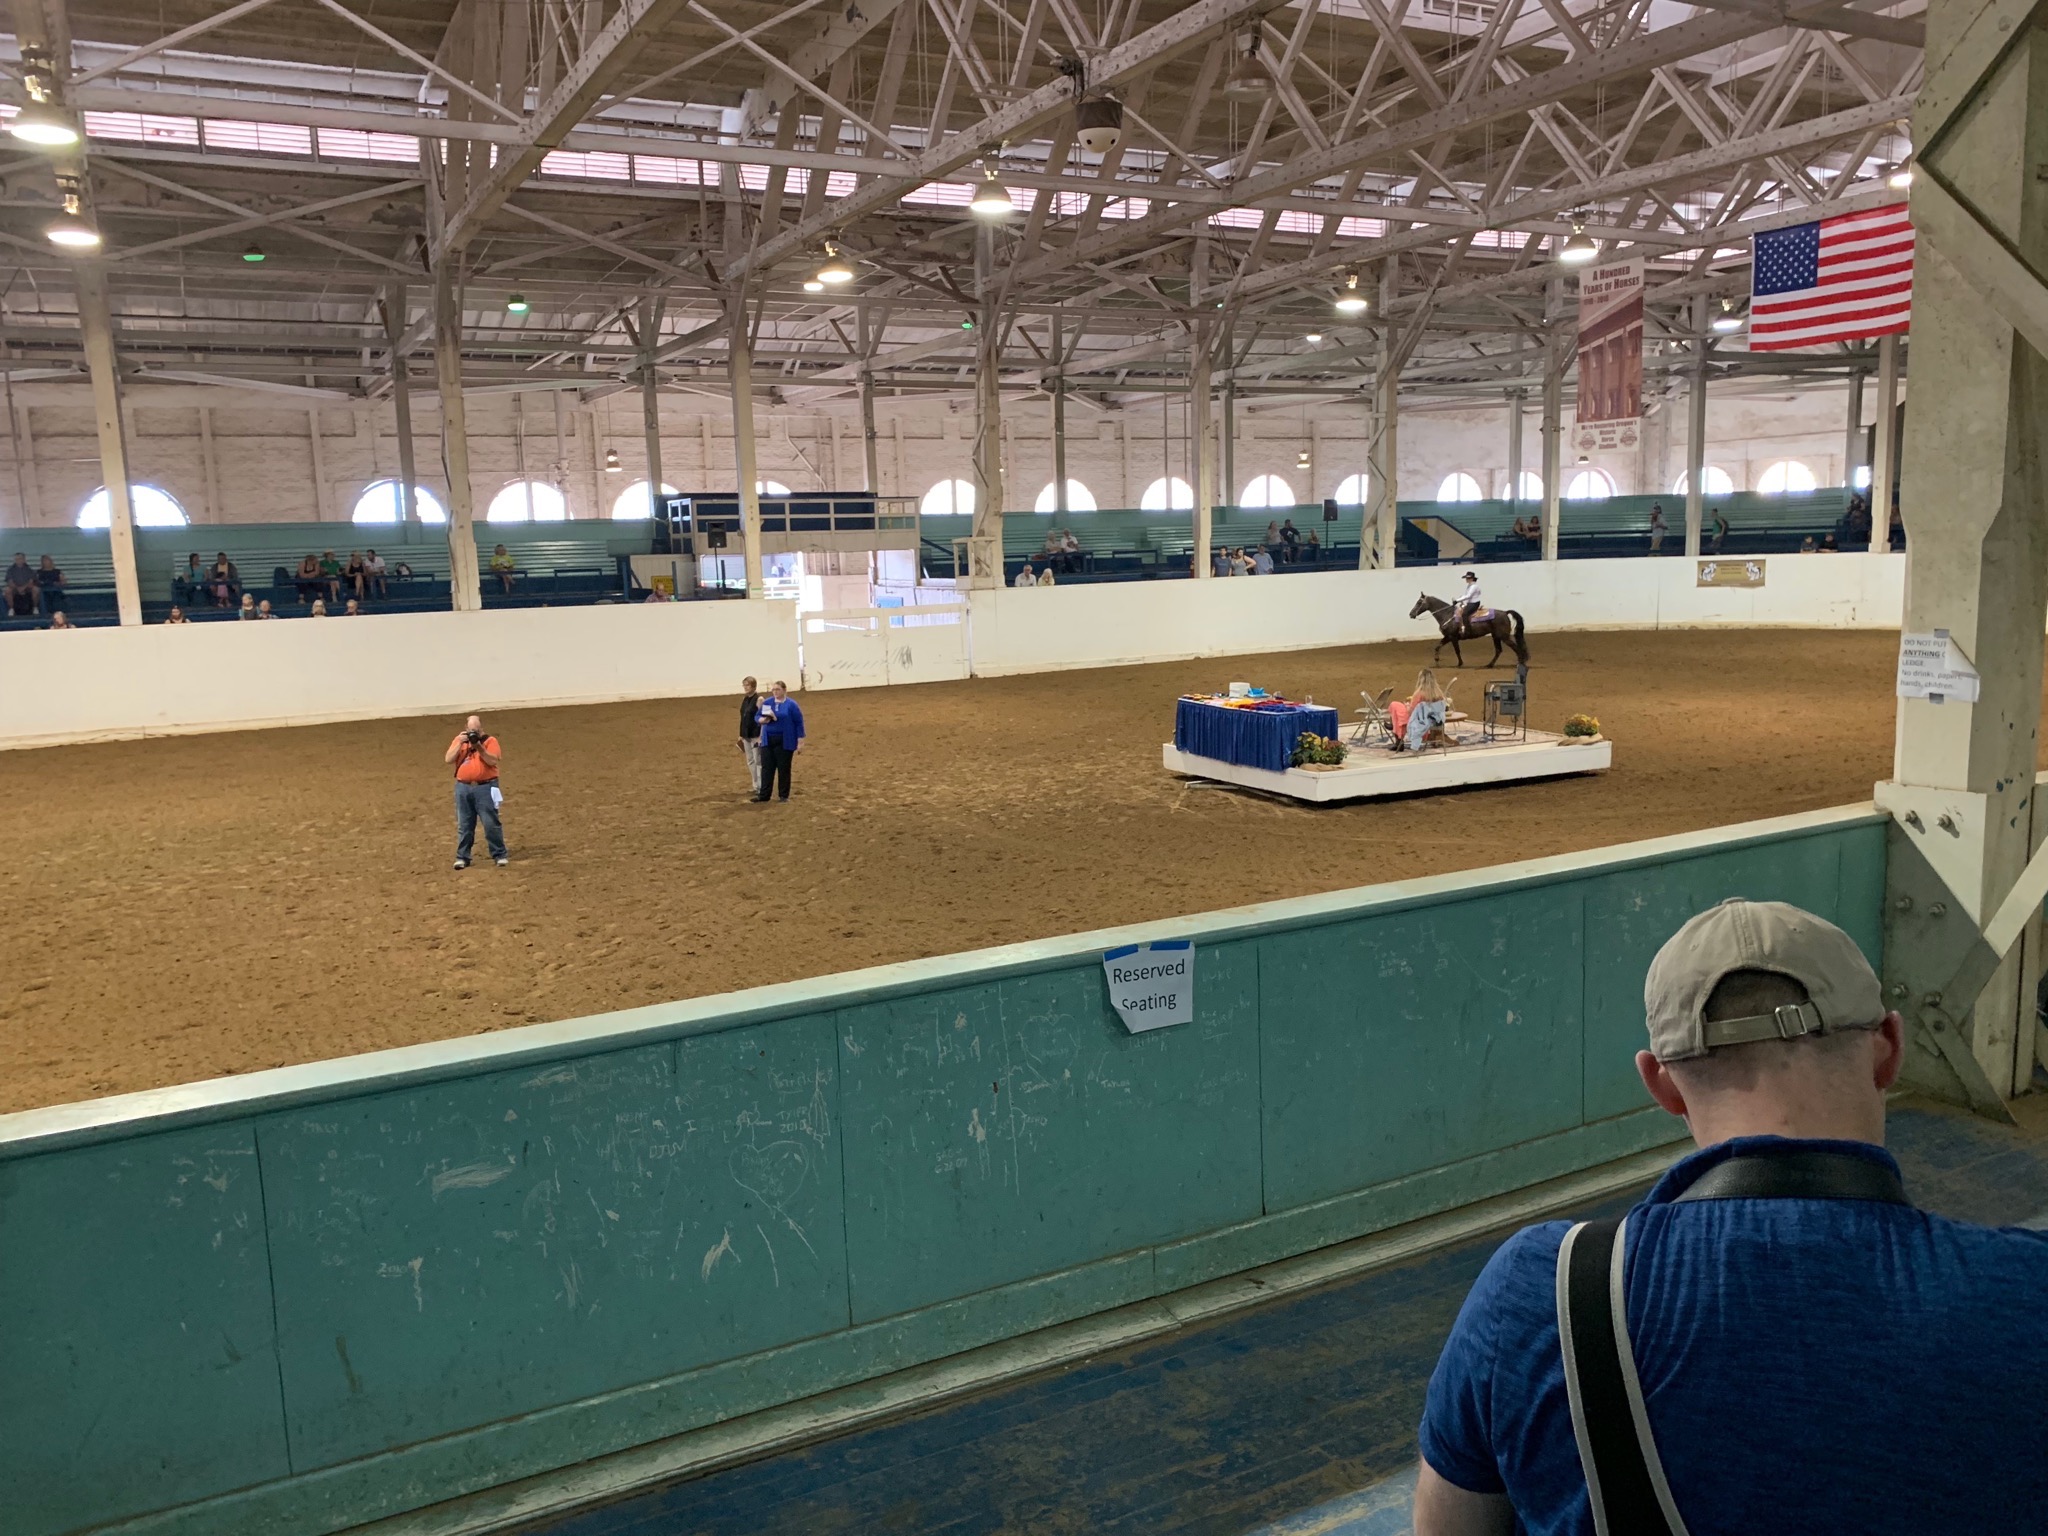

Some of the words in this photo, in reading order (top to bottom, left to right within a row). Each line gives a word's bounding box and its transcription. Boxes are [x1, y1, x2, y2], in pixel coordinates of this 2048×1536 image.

[1593, 270, 1598, 281] A
[1600, 265, 1630, 280] HUNDRED
[1583, 284, 1603, 295] YEARS
[1604, 282, 1612, 291] OF
[1614, 276, 1640, 289] HORSES
[1903, 649, 1941, 658] ANYTHING
[1113, 959, 1185, 984] Reserved
[1122, 993, 1177, 1011] Seating
